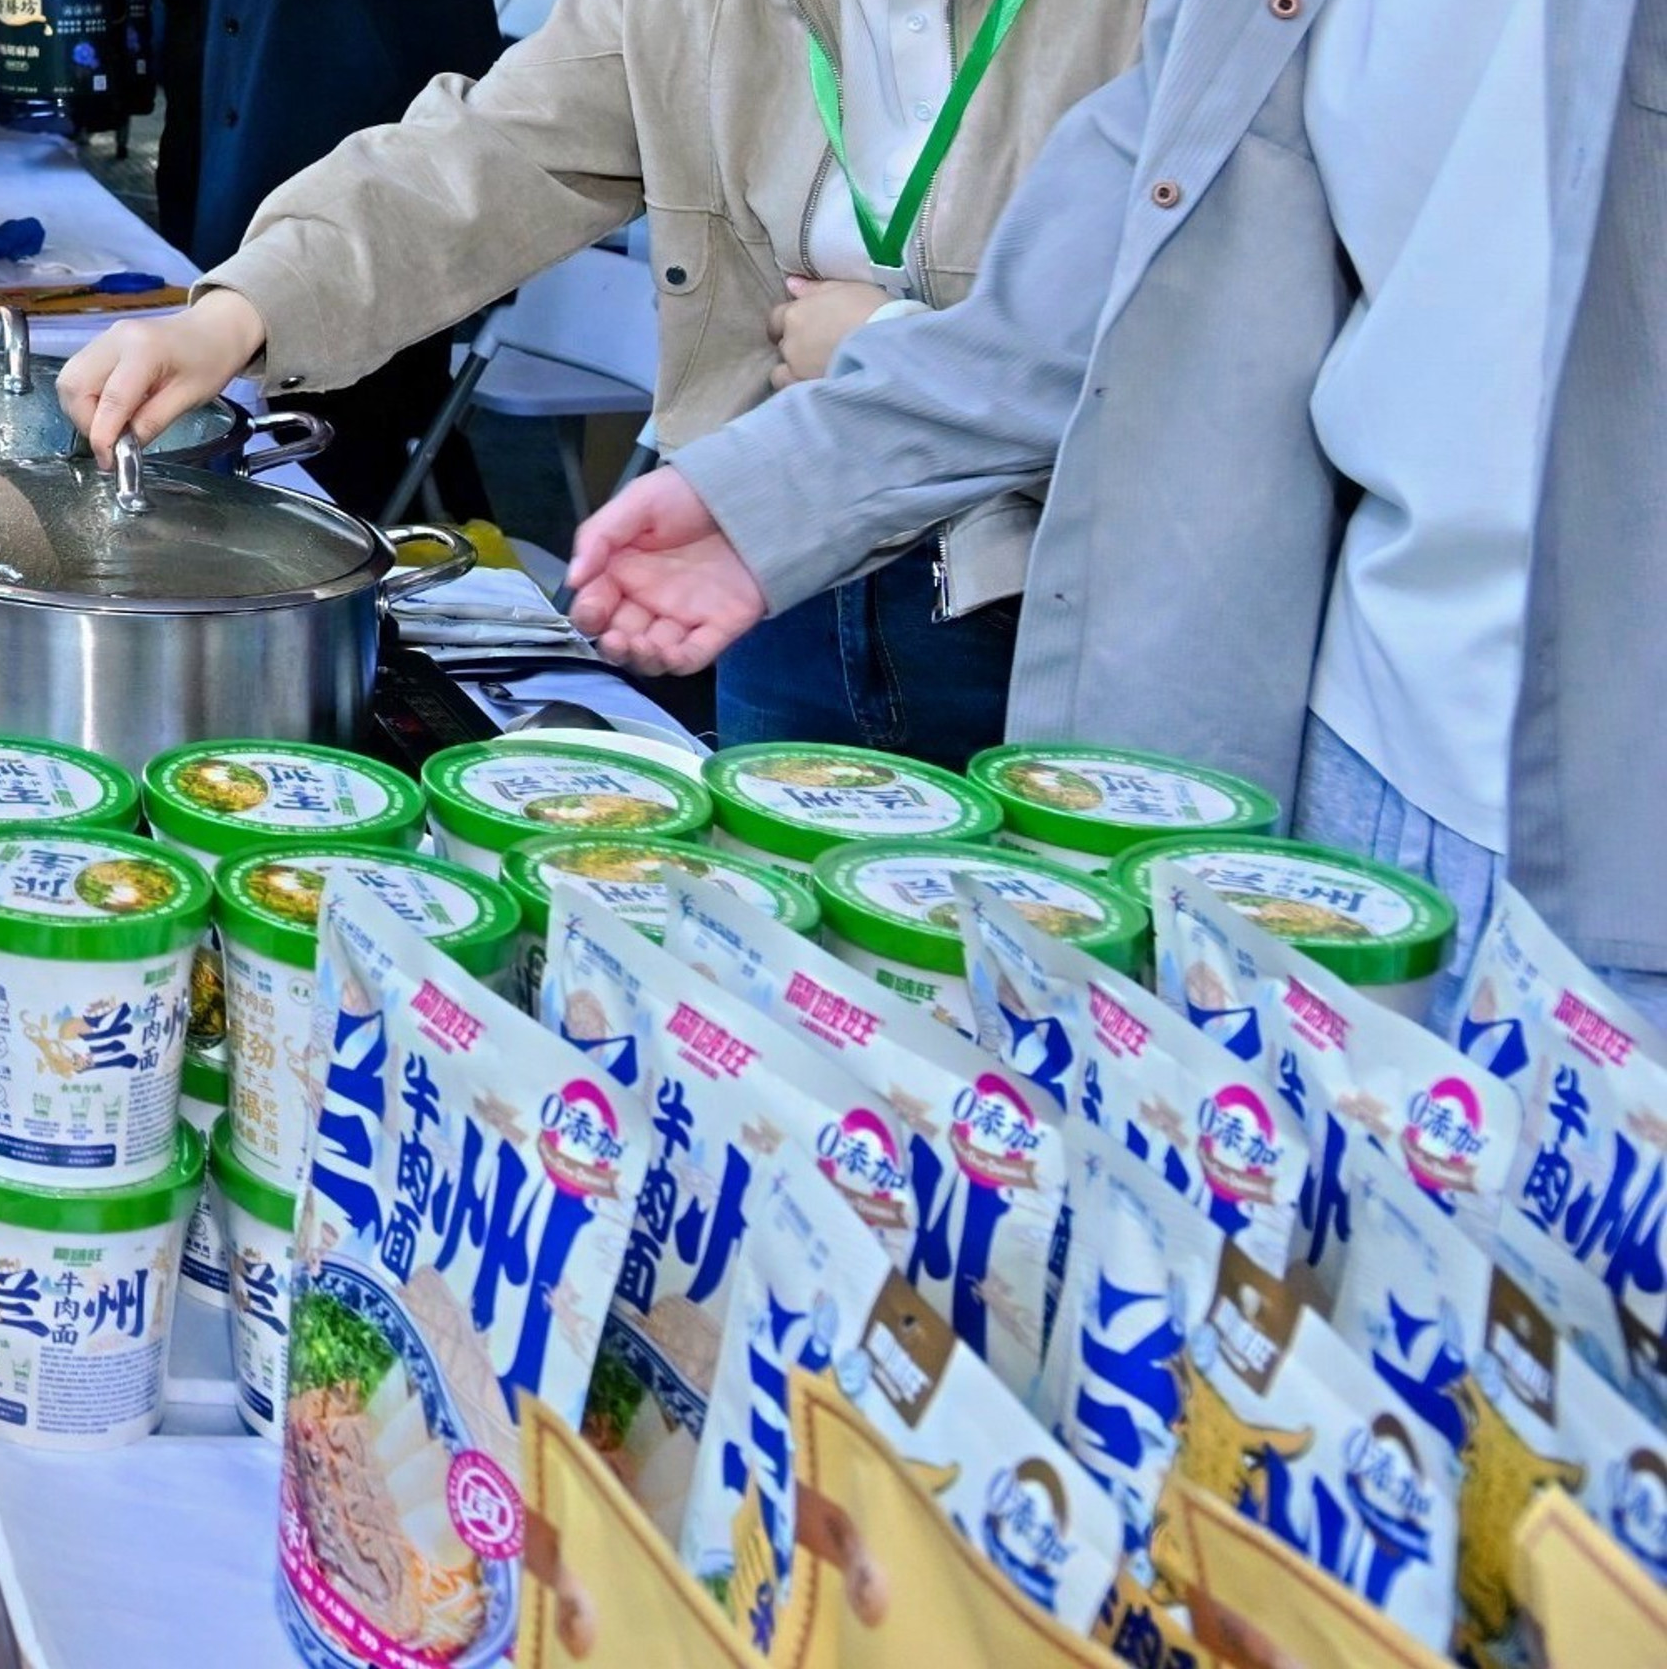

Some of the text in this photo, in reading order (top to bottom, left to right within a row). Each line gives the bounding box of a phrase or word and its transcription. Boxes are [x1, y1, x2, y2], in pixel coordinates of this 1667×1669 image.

[137, 992, 165, 1073] 牛肉面
[541, 1092, 624, 1160] 0添加
[817, 1121, 907, 1191] 0添加
[953, 1087, 1041, 1152] 0添加
[1523, 1064, 1590, 1232] 牛肉
[379, 1052, 441, 1287] 牛肉面
[614, 1078, 695, 1317] 牛肉面
[51, 1271, 83, 1346] 牛肉面
[83, 1268, 148, 1338] 州
[435, 1116, 593, 1425] 州
